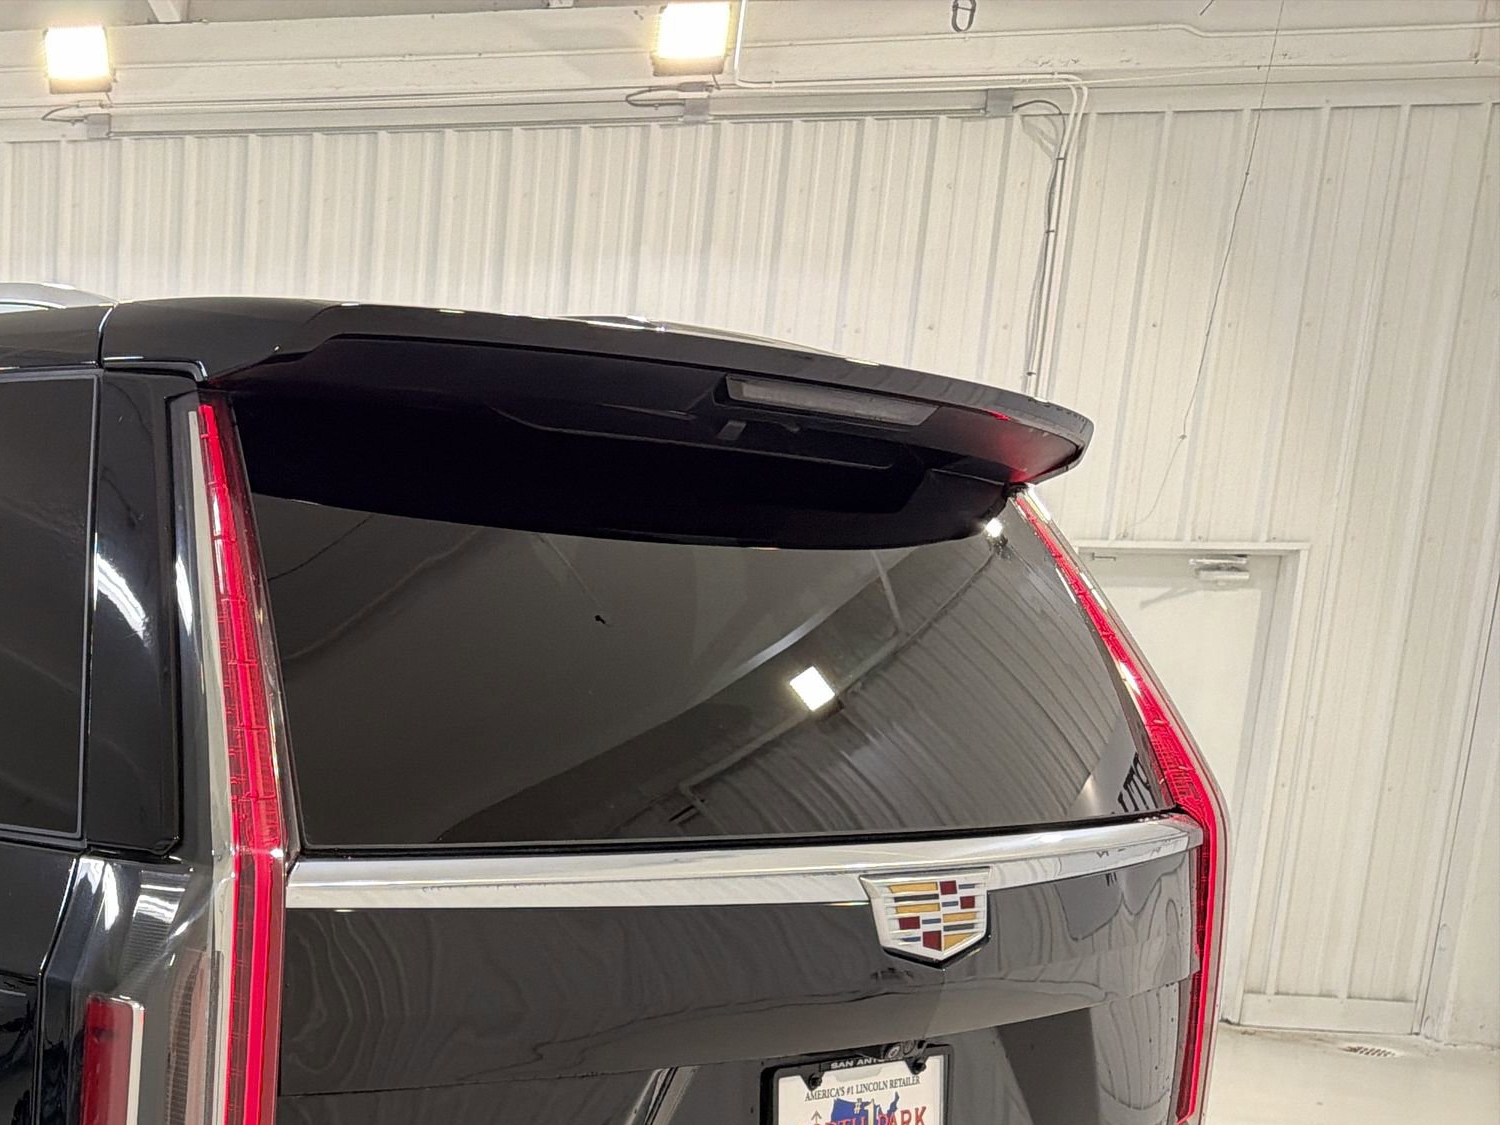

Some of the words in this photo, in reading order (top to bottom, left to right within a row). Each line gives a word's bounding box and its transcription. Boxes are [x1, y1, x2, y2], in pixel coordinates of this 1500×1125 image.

[830, 1060, 854, 1070] SAN
[804, 1086, 845, 1102] AMERICA'S
[846, 1085, 854, 1095] #1
[855, 1079, 889, 1094] LINCOLN
[889, 1075, 921, 1089] RETAILER
